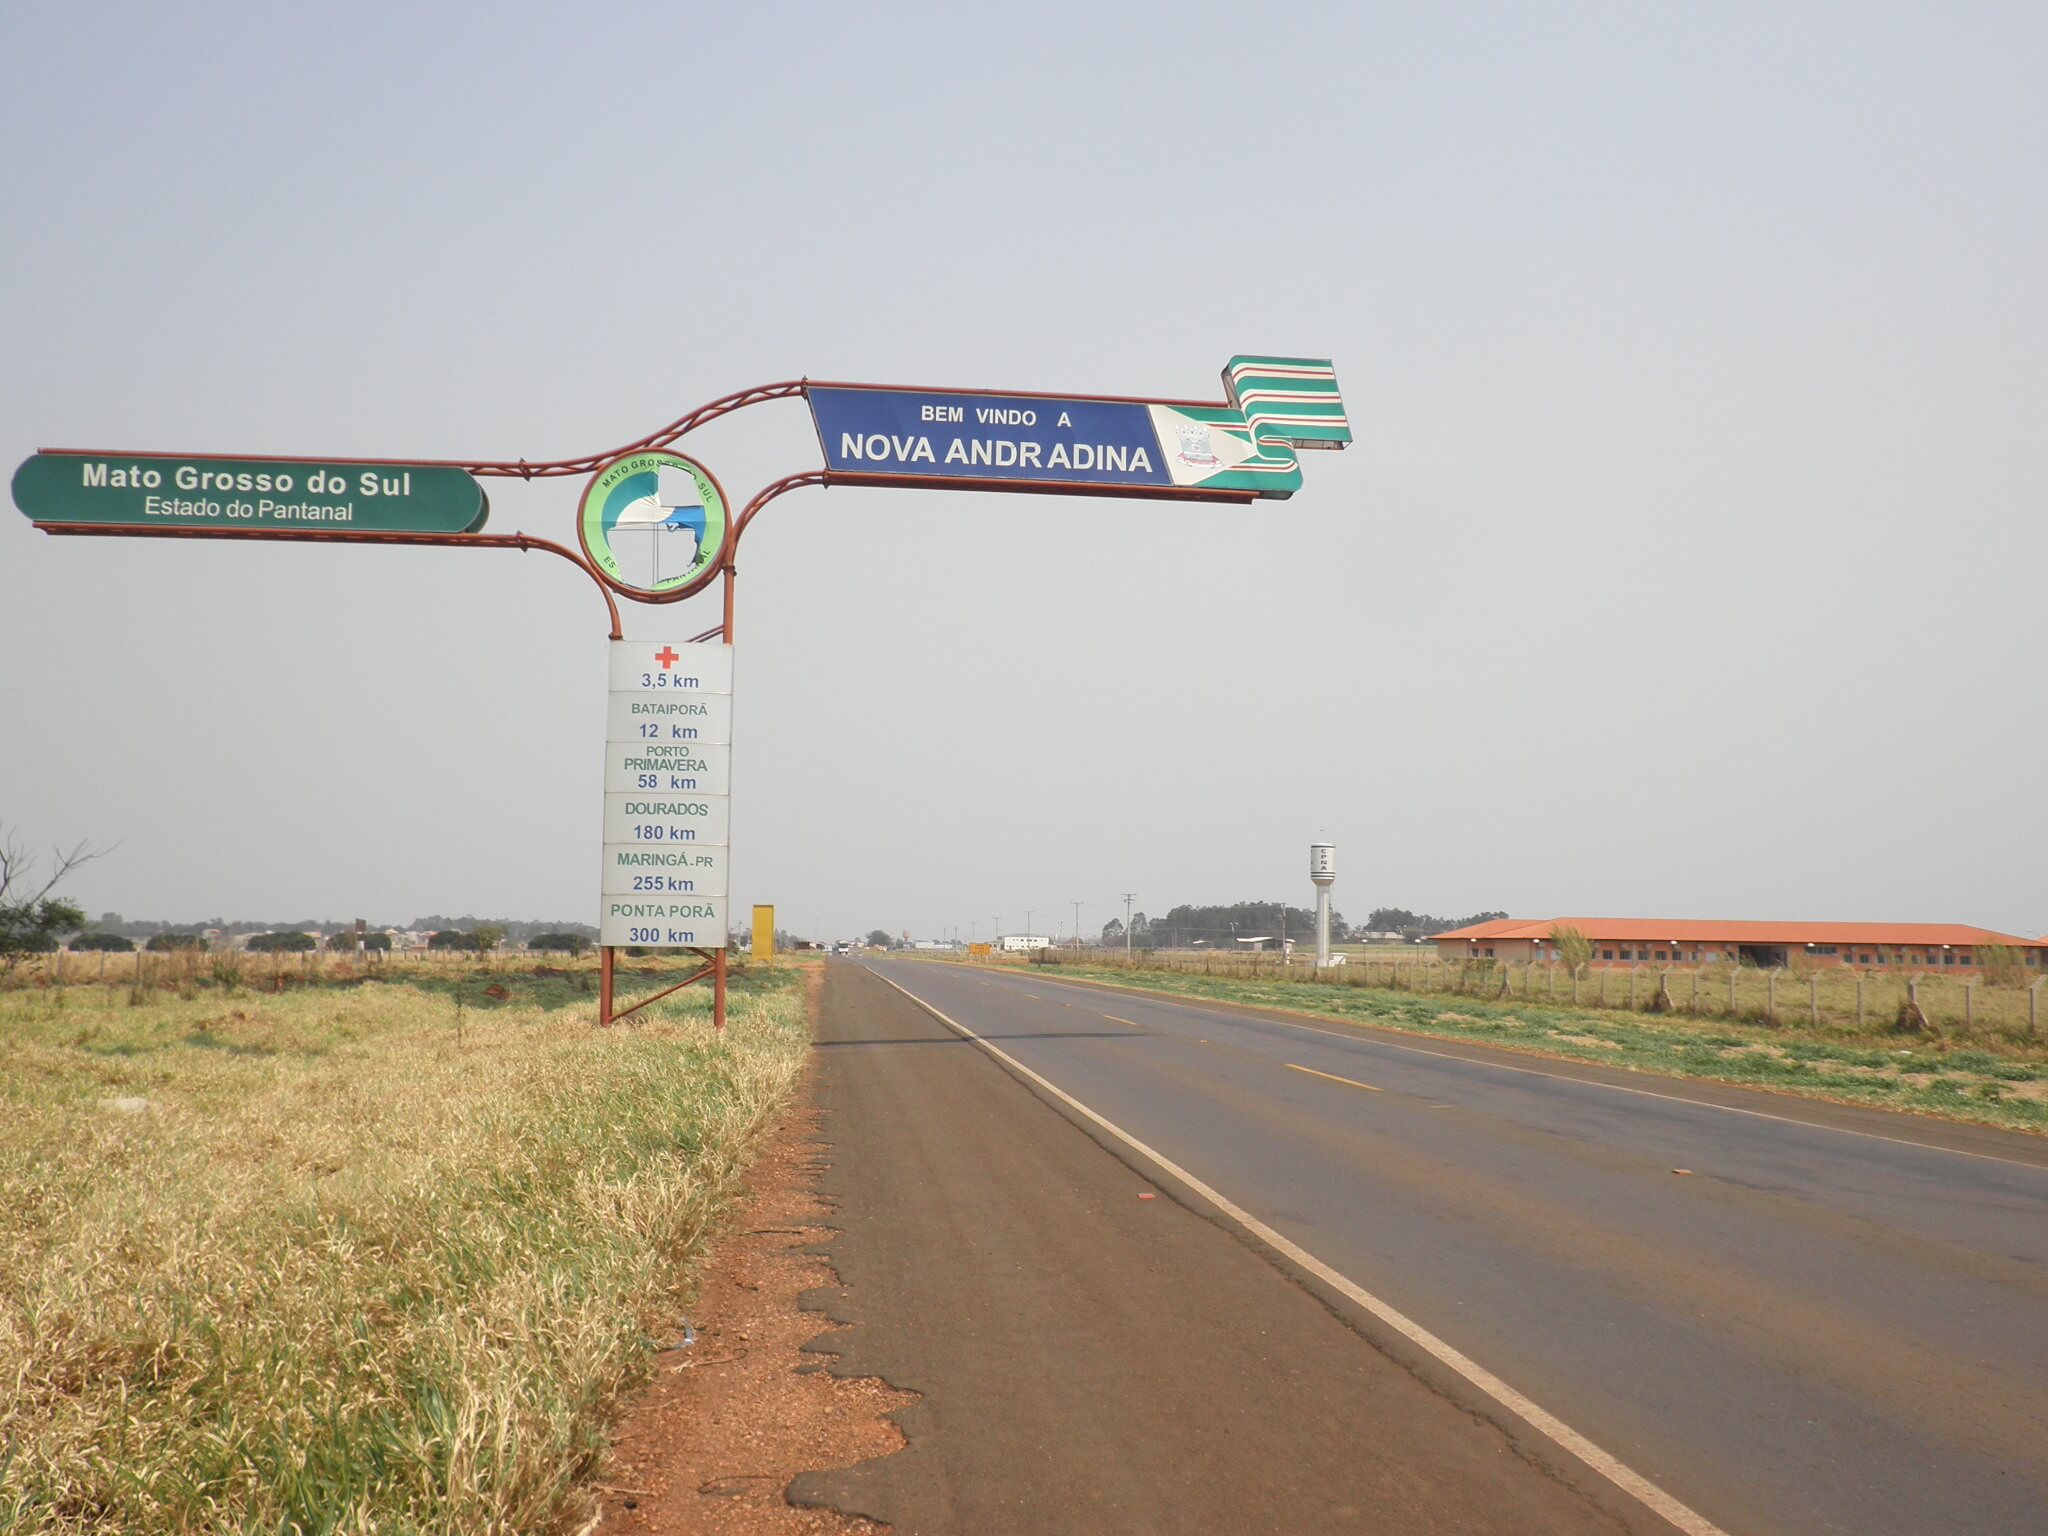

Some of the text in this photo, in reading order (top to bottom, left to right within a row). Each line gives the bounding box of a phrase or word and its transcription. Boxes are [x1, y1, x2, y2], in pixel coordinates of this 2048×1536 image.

[921, 405, 1072, 427] BEM VINDO A
[841, 432, 936, 463] NOVA
[82, 463, 410, 496] Mato Grosso do Sul
[602, 466, 629, 488] MATO
[698, 482, 713, 503] SUL
[145, 495, 352, 521] Estado do Pantanal
[642, 673, 699, 689] 3,5 km
[639, 724, 698, 738] 12 km
[646, 746, 690, 757] PORTO
[624, 758, 708, 771] PRIMAVERA
[638, 774, 696, 789] 58 km
[625, 802, 709, 816] DOURADOS
[634, 825, 696, 840] 180 km
[633, 876, 694, 891] 255 km
[611, 903, 715, 918] PONTA PORÃ
[629, 928, 694, 942] 300 km
